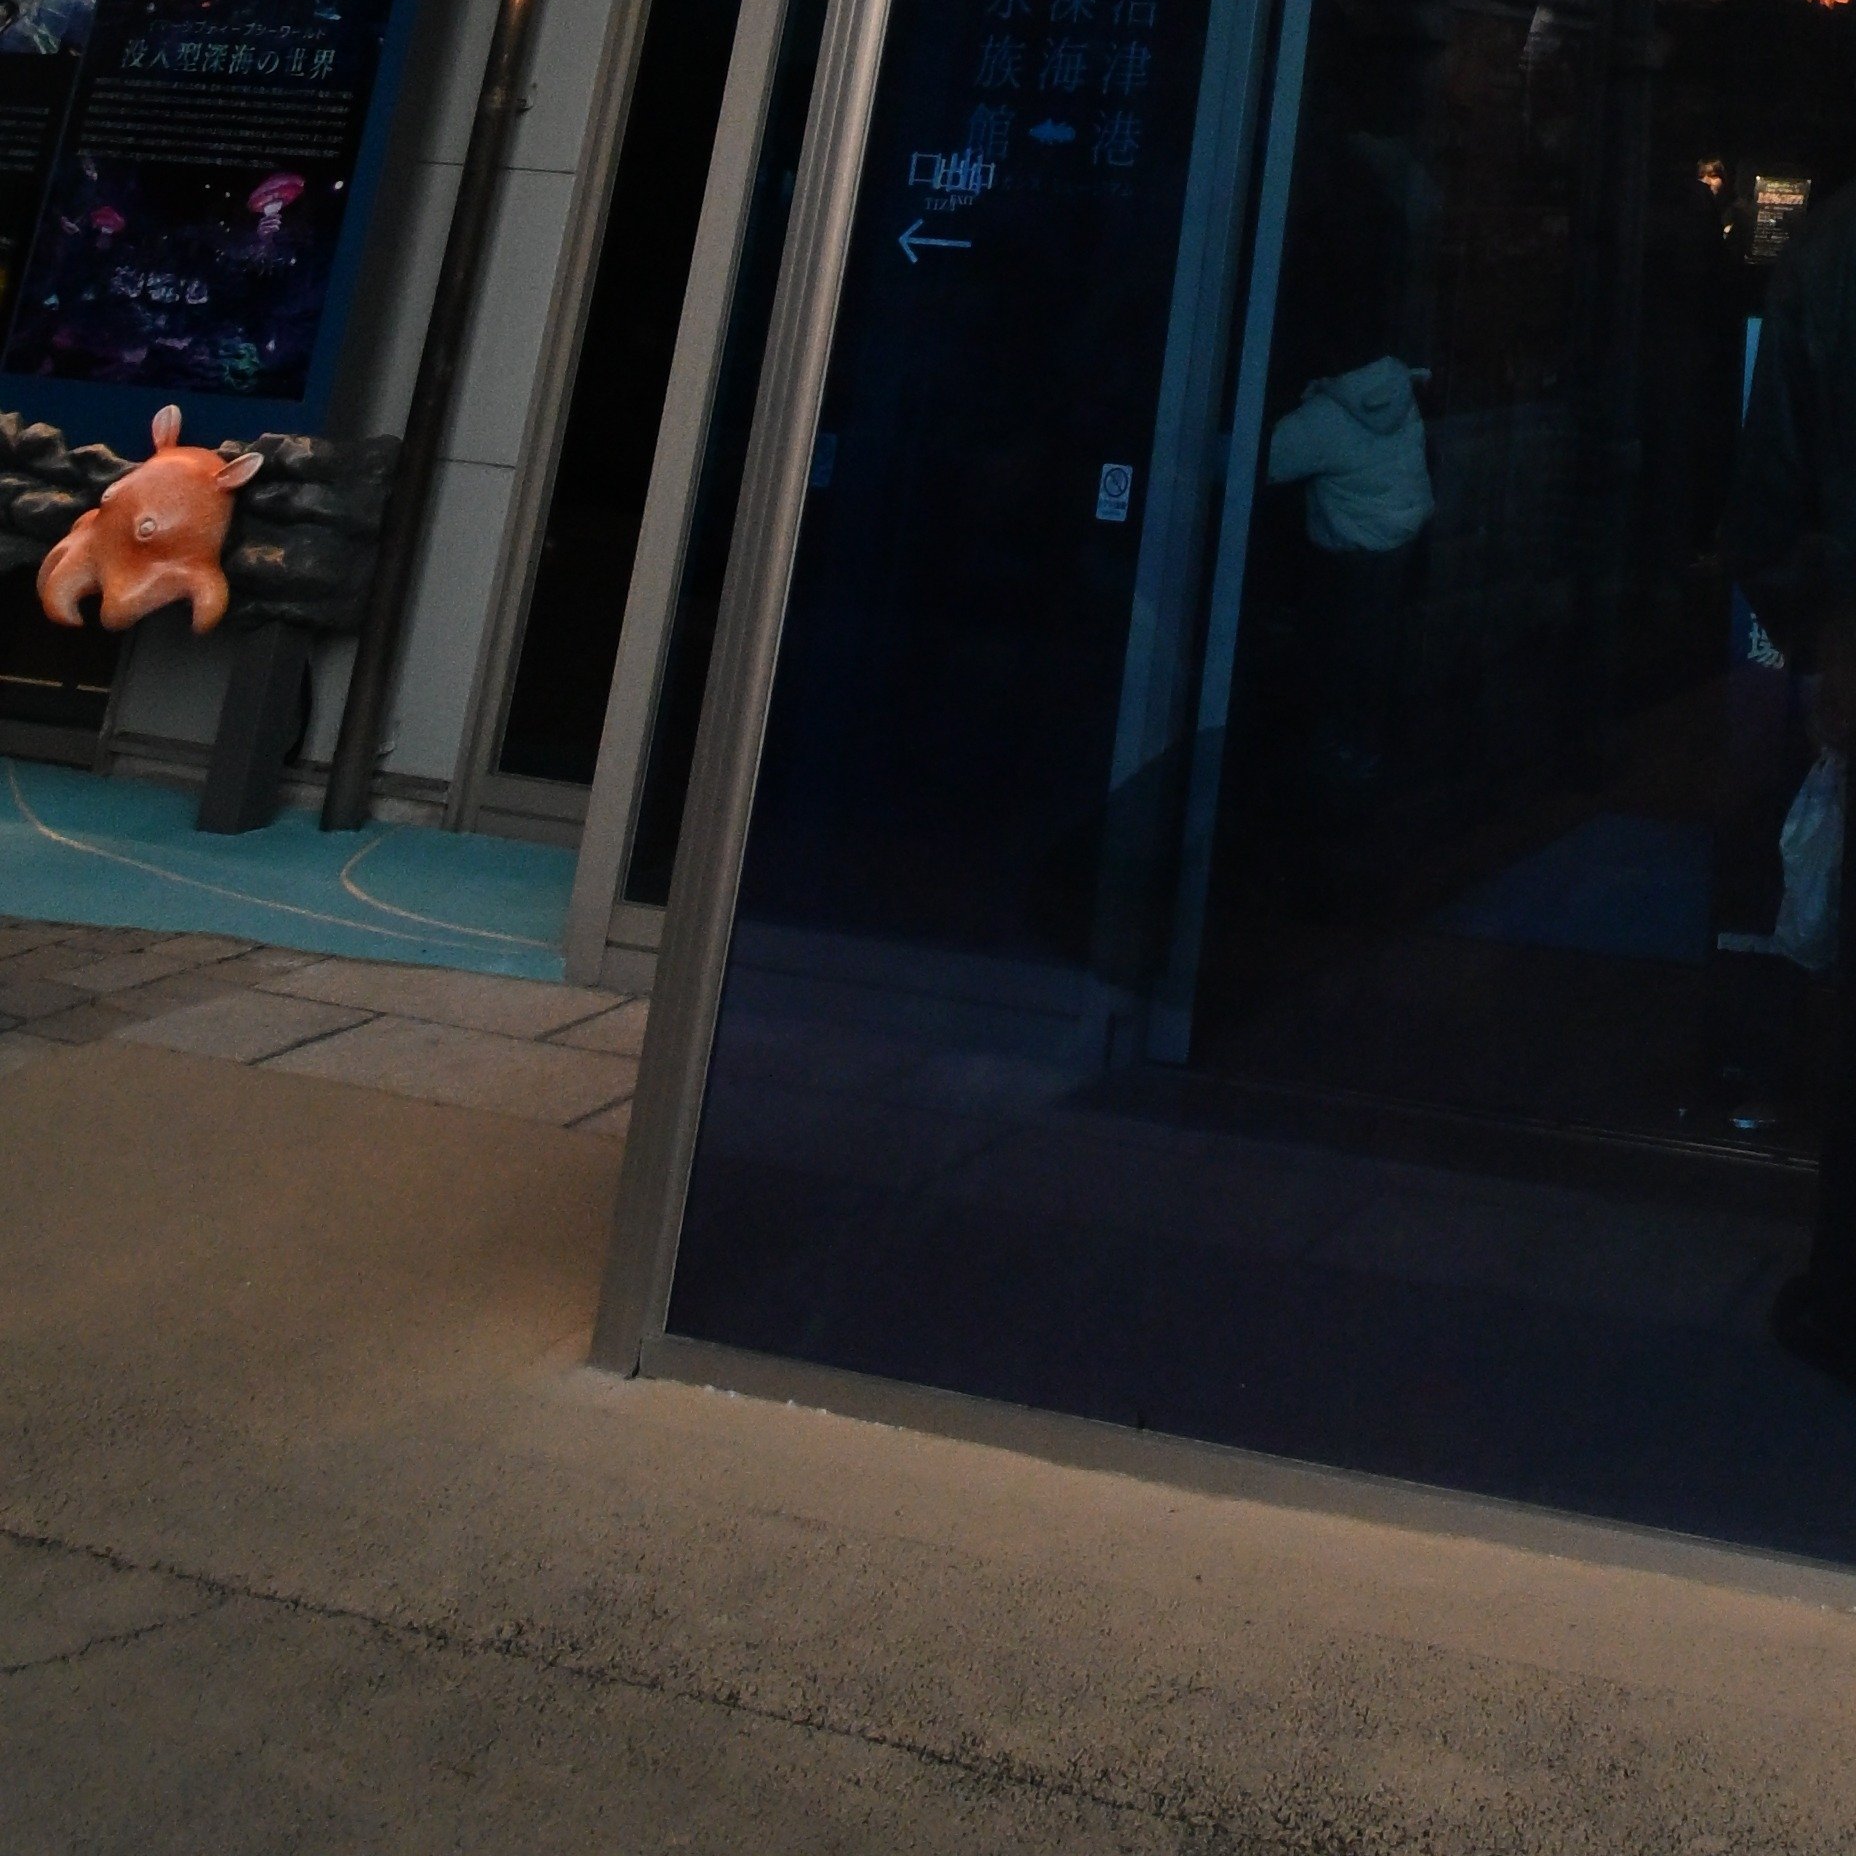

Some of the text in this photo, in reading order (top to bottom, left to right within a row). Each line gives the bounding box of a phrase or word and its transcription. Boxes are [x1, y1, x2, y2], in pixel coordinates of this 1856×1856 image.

[121, 38, 337, 81] 没入型深海の世界
